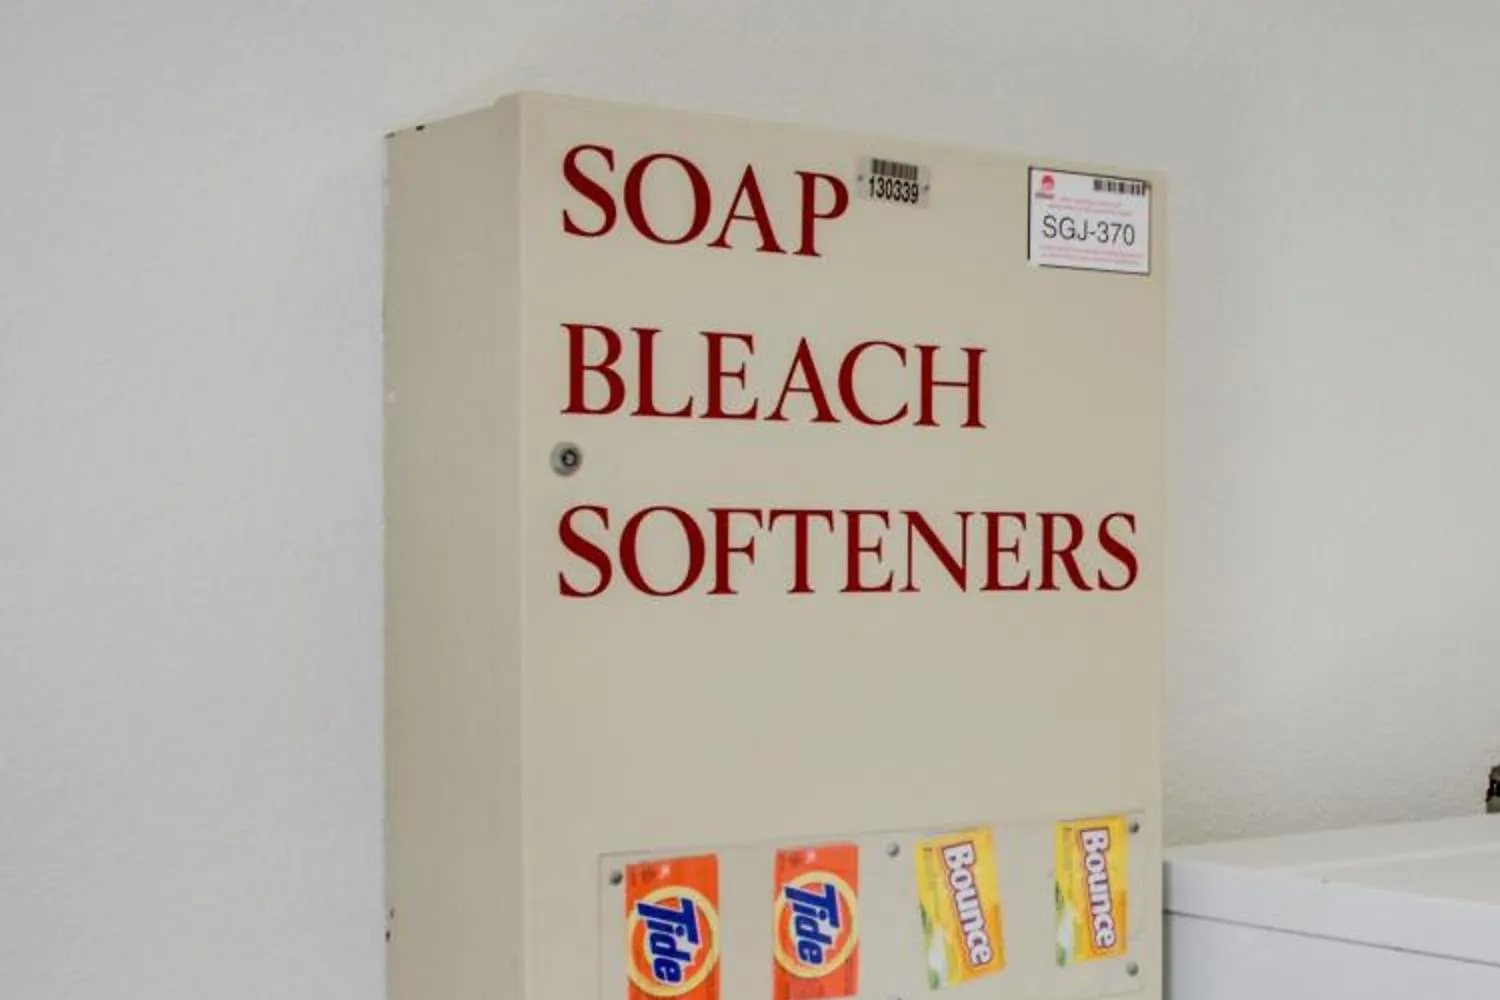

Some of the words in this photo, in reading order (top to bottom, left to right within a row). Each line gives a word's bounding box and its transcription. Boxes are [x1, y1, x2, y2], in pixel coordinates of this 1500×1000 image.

[562, 143, 850, 258] SOAP
[869, 176, 919, 205] 130339
[1042, 214, 1135, 246] SGJ-370
[560, 322, 987, 429] BLEACH
[556, 504, 1139, 598] SOFTENERS
[783, 883, 841, 965] Tide
[942, 841, 994, 968] Bounce
[1080, 827, 1117, 949] Bounce
[636, 897, 699, 983] Tide
